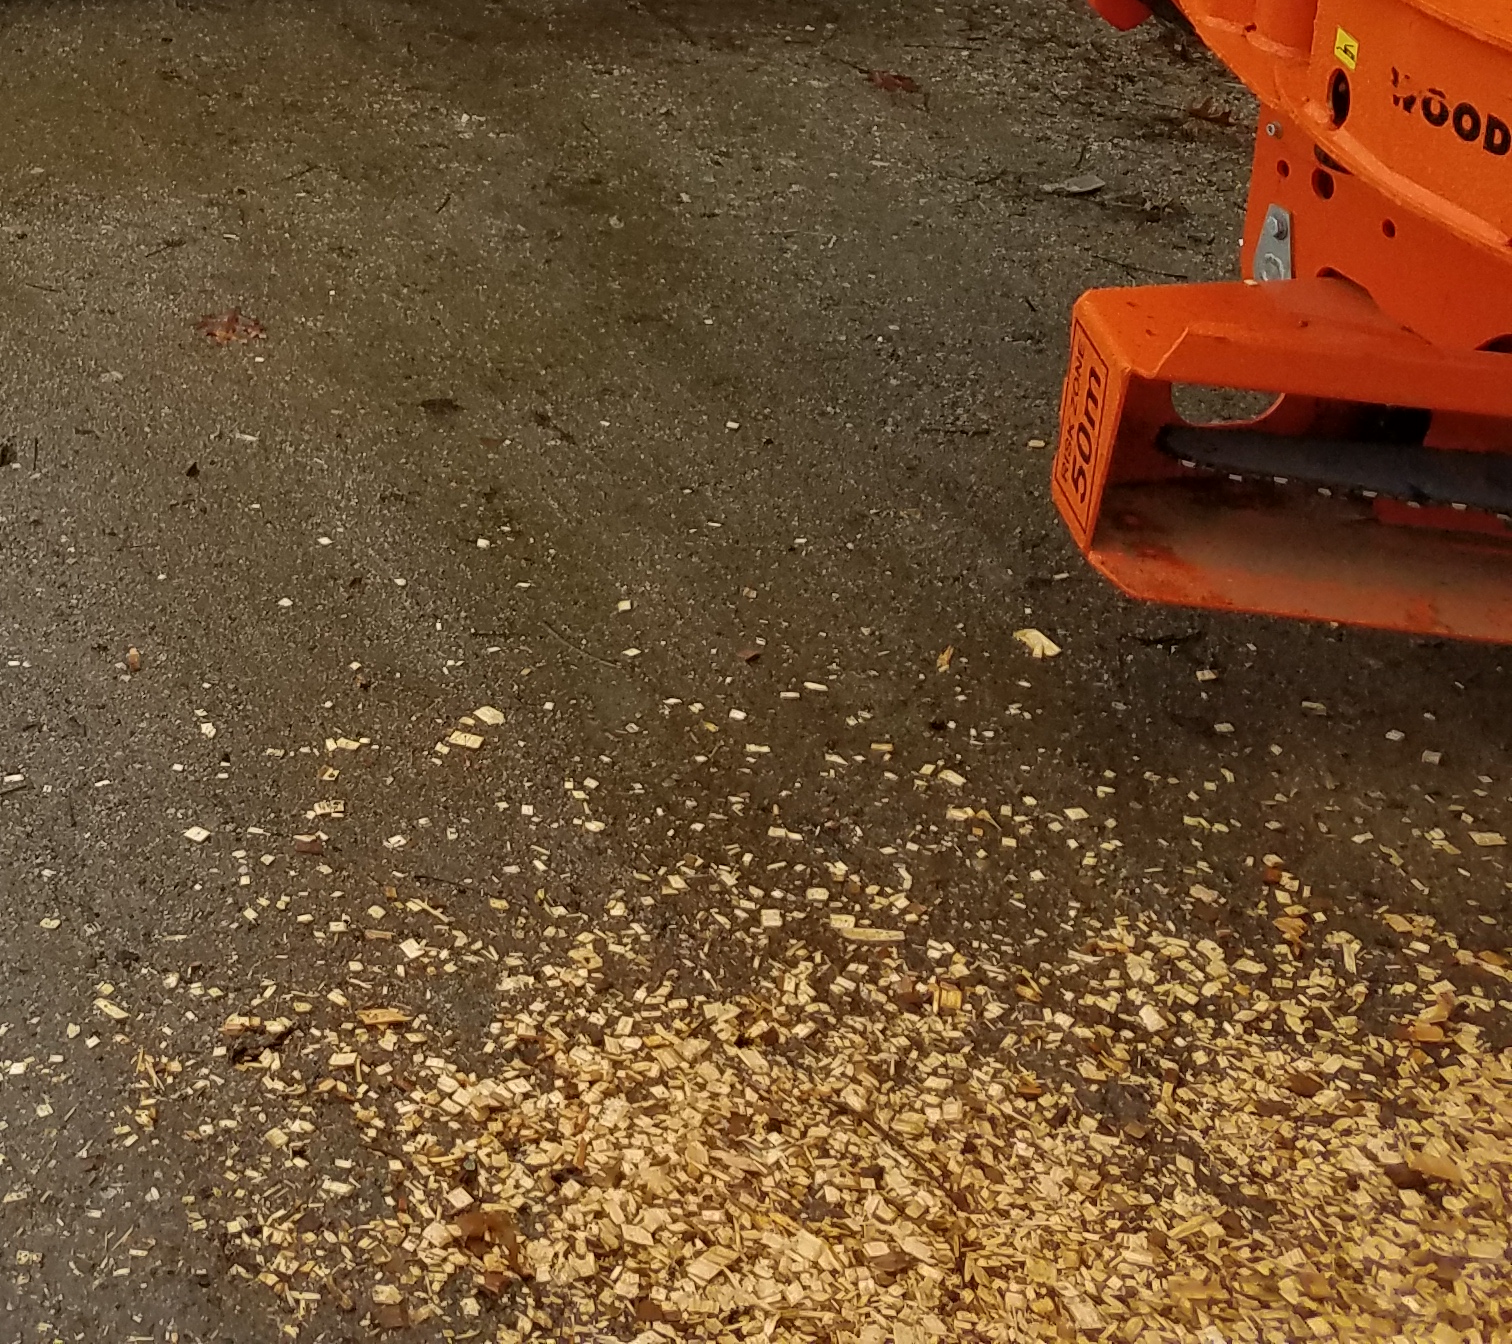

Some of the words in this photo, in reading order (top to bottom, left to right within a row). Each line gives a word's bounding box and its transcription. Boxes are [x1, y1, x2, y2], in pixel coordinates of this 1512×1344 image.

[1061, 423, 1075, 483] RISK
[1070, 339, 1086, 416] ZONE
[1071, 366, 1101, 504] 50m
